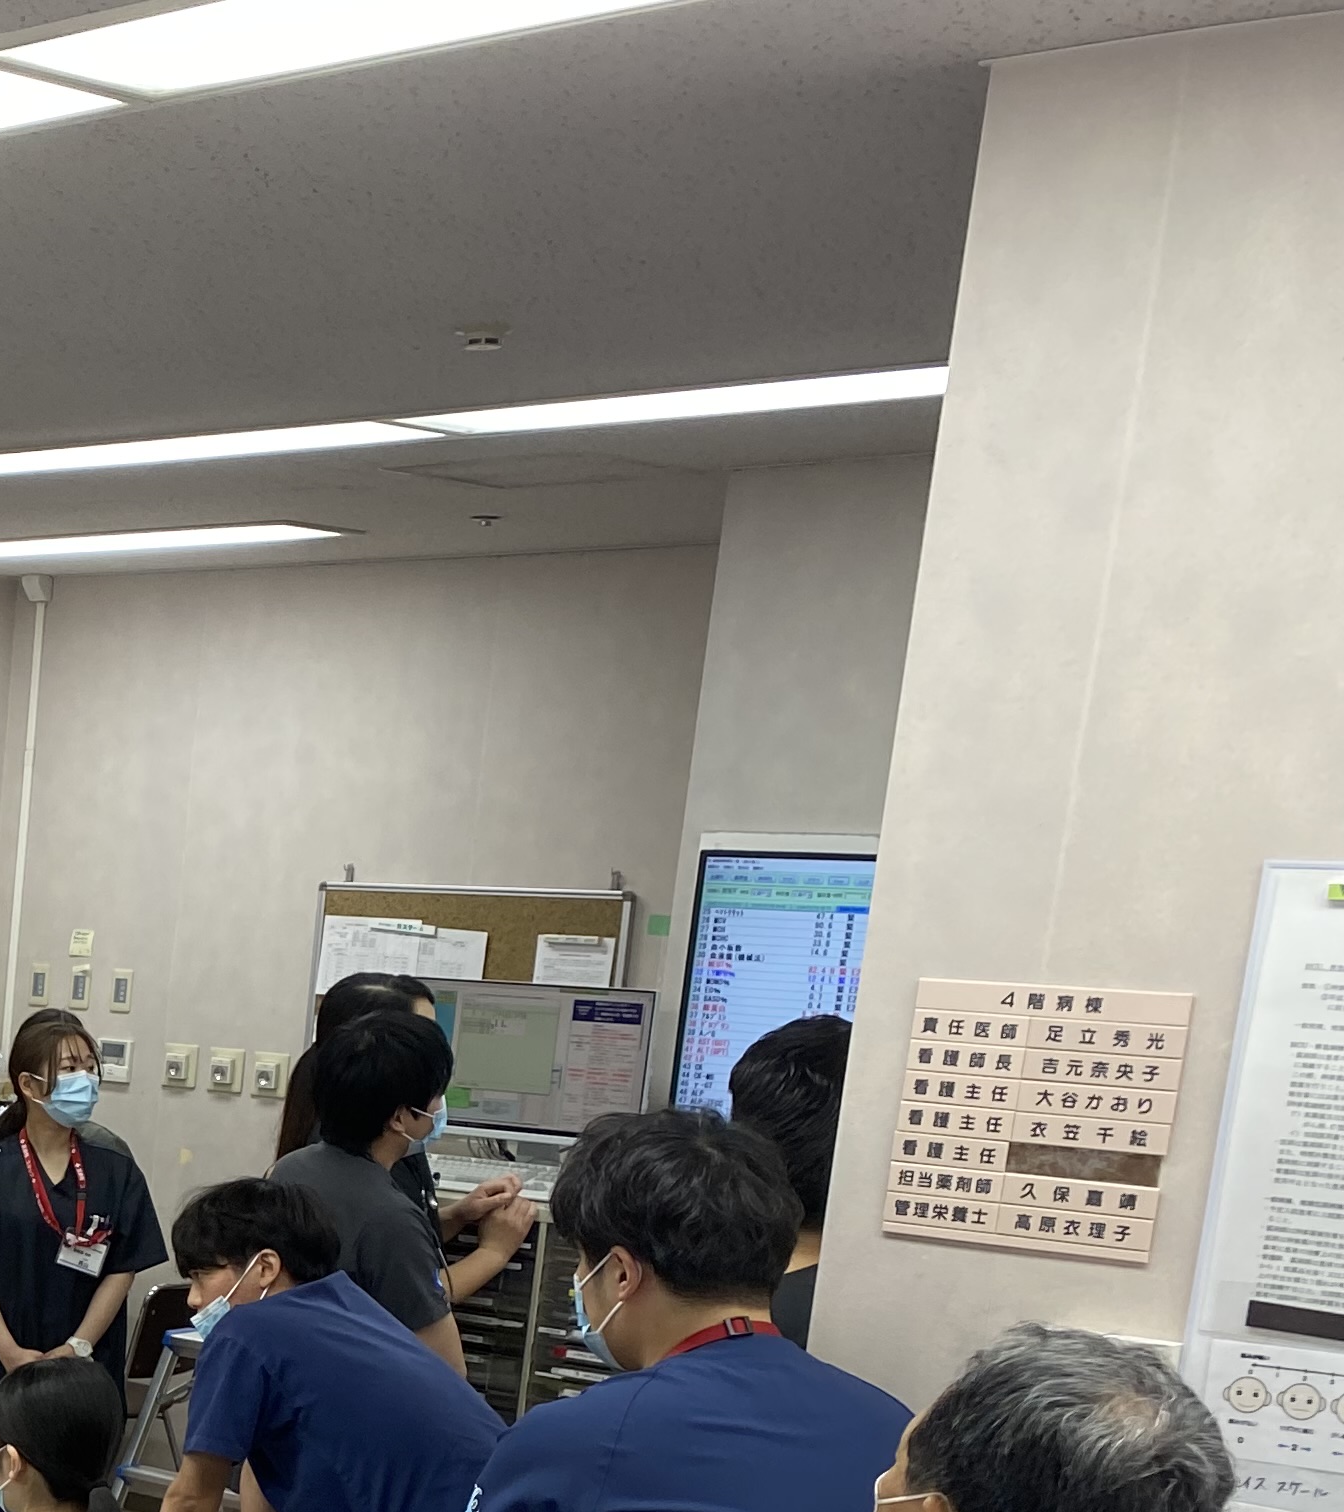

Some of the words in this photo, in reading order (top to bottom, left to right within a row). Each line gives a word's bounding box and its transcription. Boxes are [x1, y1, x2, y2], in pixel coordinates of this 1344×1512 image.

[1000, 991, 1105, 1014] 4階病棟
[921, 1016, 1019, 1040] 責任医師
[1045, 1025, 1166, 1051] 足立秀光
[917, 1047, 1013, 1071] 看護師長
[1041, 1057, 1161, 1083] 吉元奈央子
[913, 1078, 1009, 1104] 看護主任
[1036, 1090, 1154, 1115] 大谷かおり
[908, 1109, 1004, 1134] 看護主任
[1030, 1121, 1149, 1148] 衣笠千絵
[902, 1139, 997, 1165] 看護主任
[897, 1169, 994, 1195] 担当薬剤師
[894, 1199, 989, 1225] 管理栄養士
[1014, 1214, 1132, 1242] 高原衣理子
